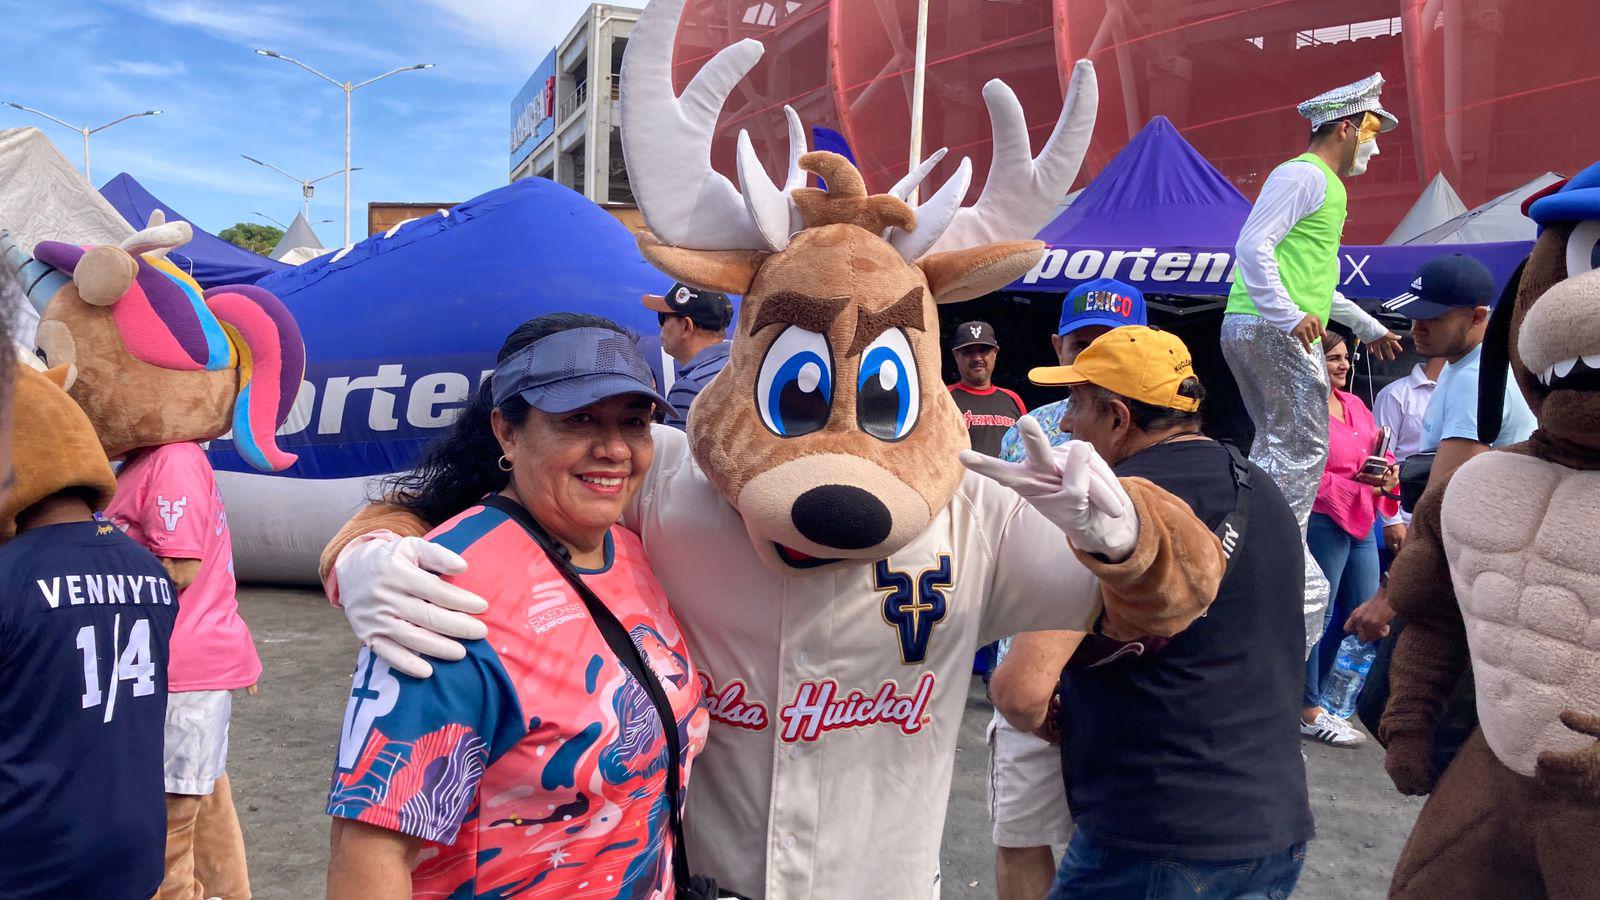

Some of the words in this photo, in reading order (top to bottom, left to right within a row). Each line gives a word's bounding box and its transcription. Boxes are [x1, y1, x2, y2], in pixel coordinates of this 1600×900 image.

[1023, 247, 1238, 285] porten
[1336, 254, 1372, 286] X
[1073, 290, 1132, 318] MEXICO
[37, 574, 171, 609] VENNYTO
[781, 673, 935, 741] Huichol
